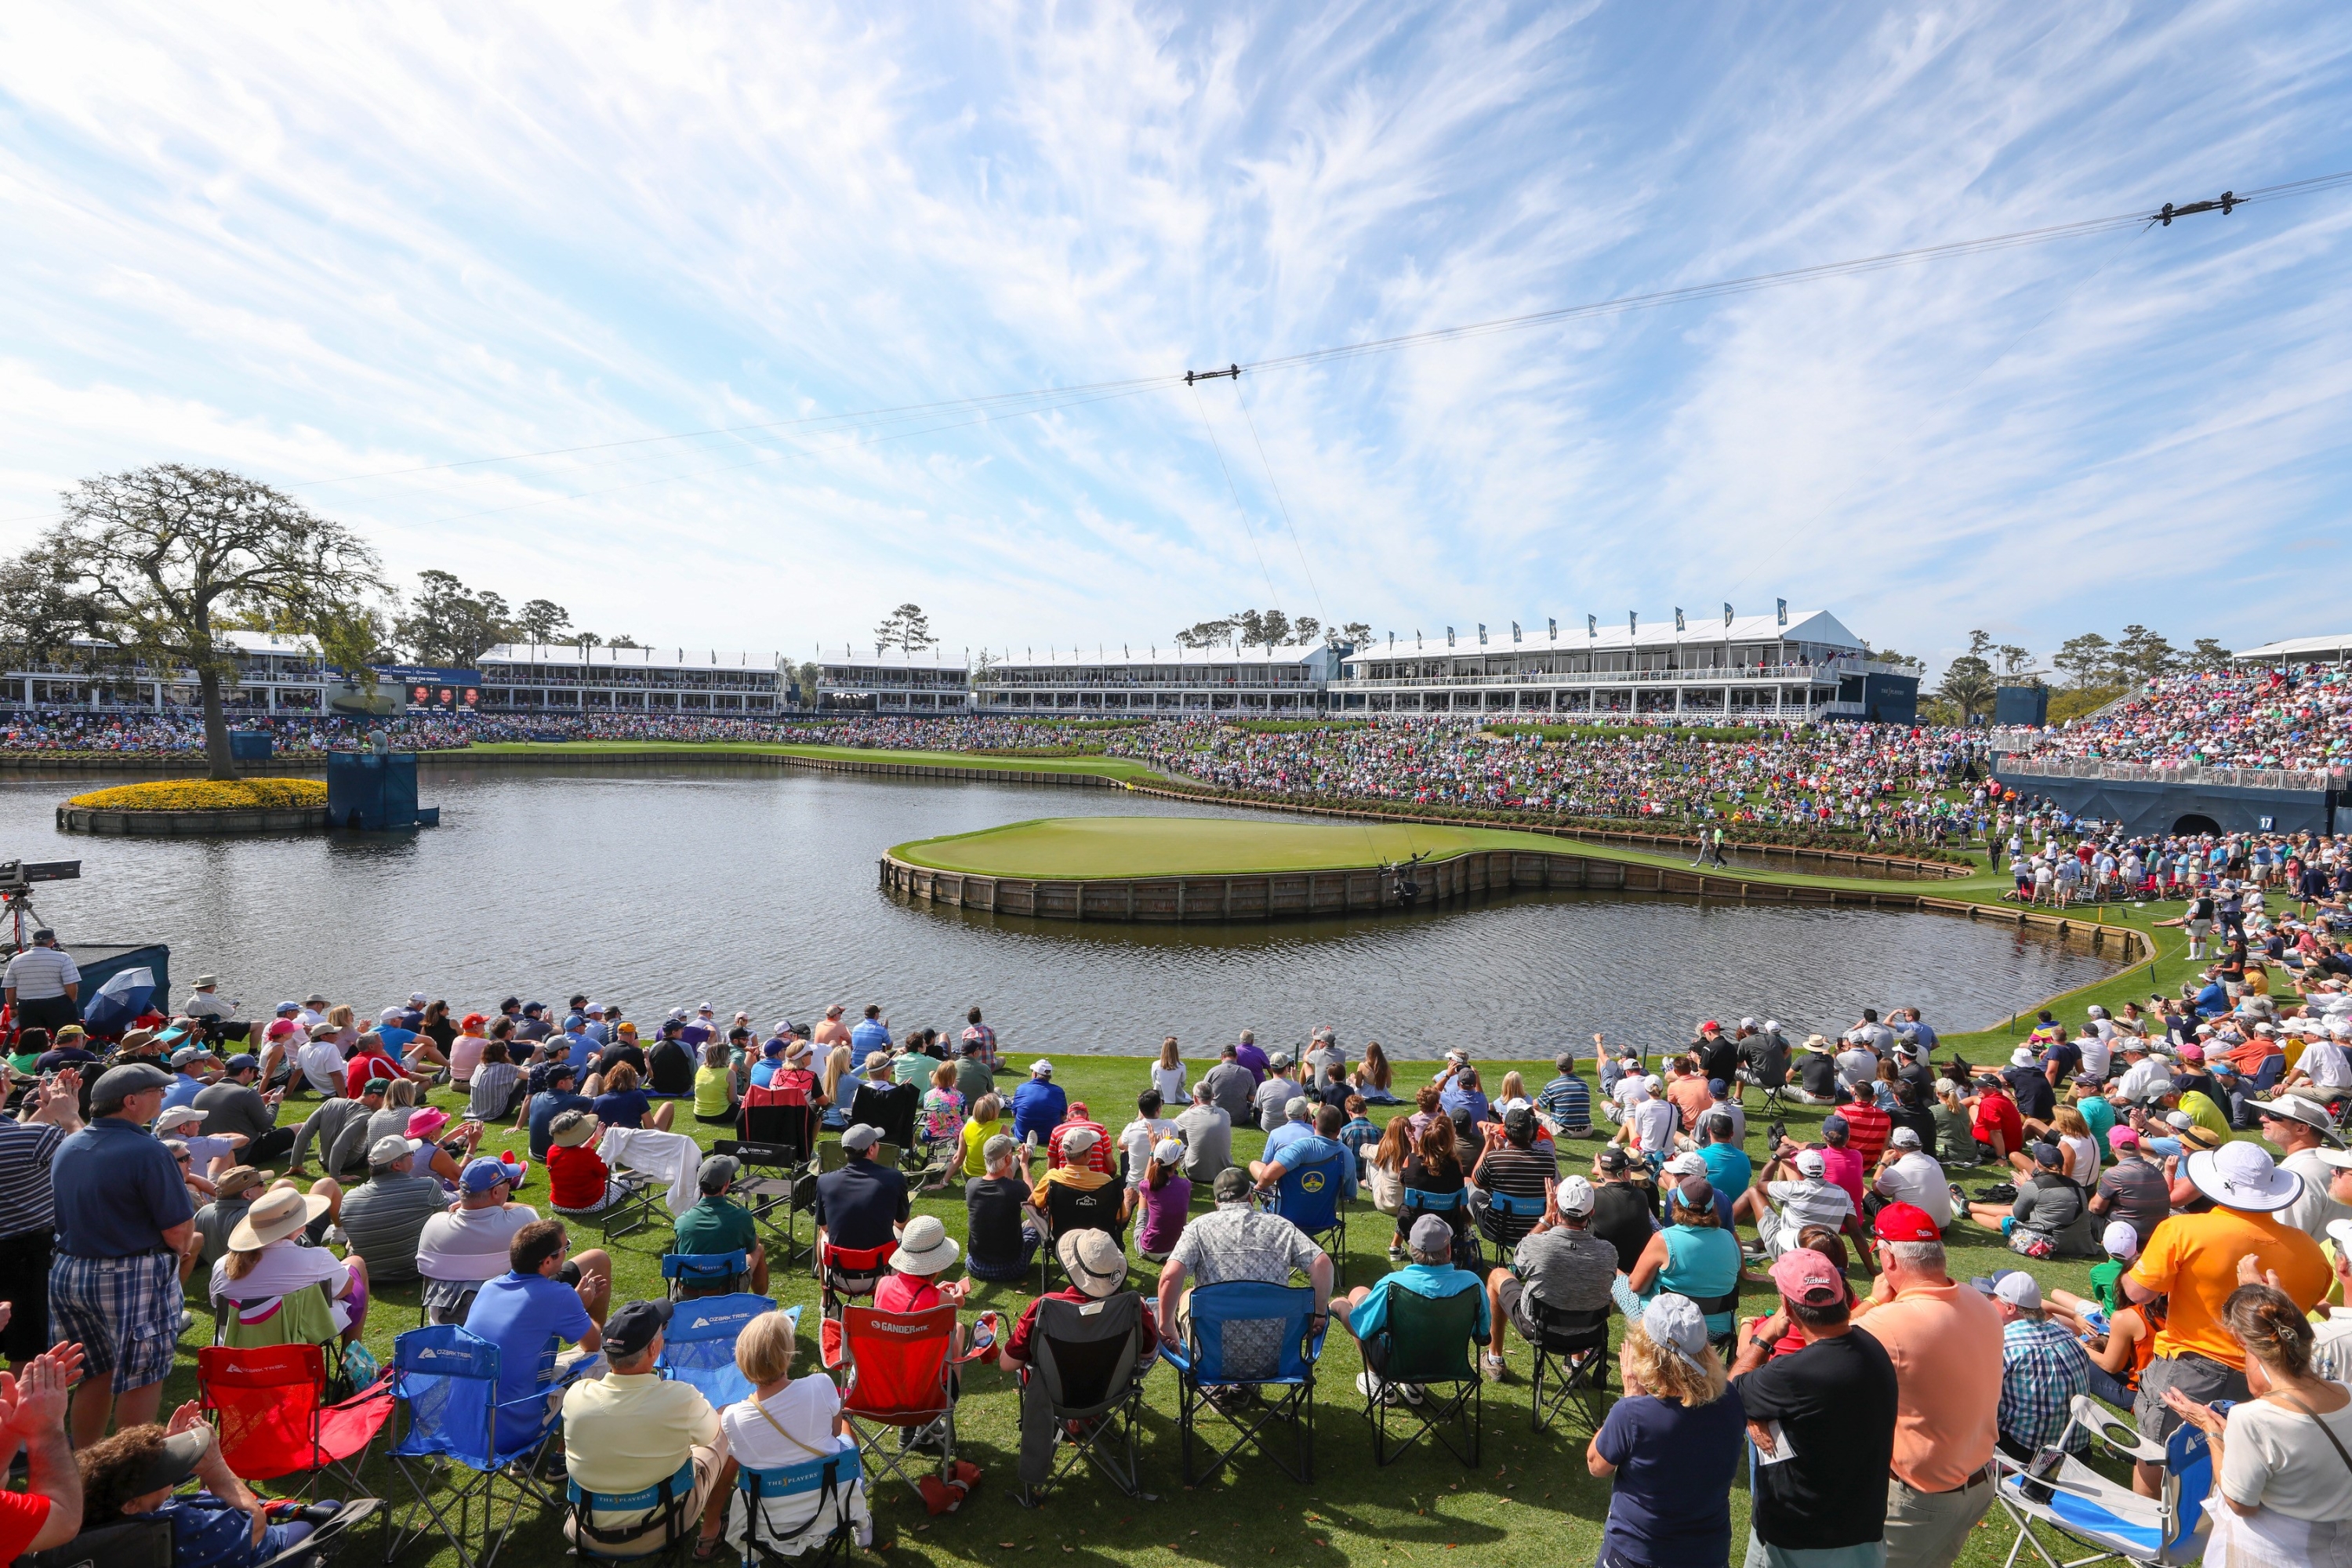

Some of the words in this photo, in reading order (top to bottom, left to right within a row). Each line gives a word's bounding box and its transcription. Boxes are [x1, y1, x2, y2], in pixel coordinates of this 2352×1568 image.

[2261, 817, 2272, 828] 17
[1804, 1276, 1830, 1285] Titleist
[881, 1322, 915, 1334] GANDER
[788, 1472, 818, 1483] PLAYERS
[619, 1494, 651, 1502] PLAYERS
